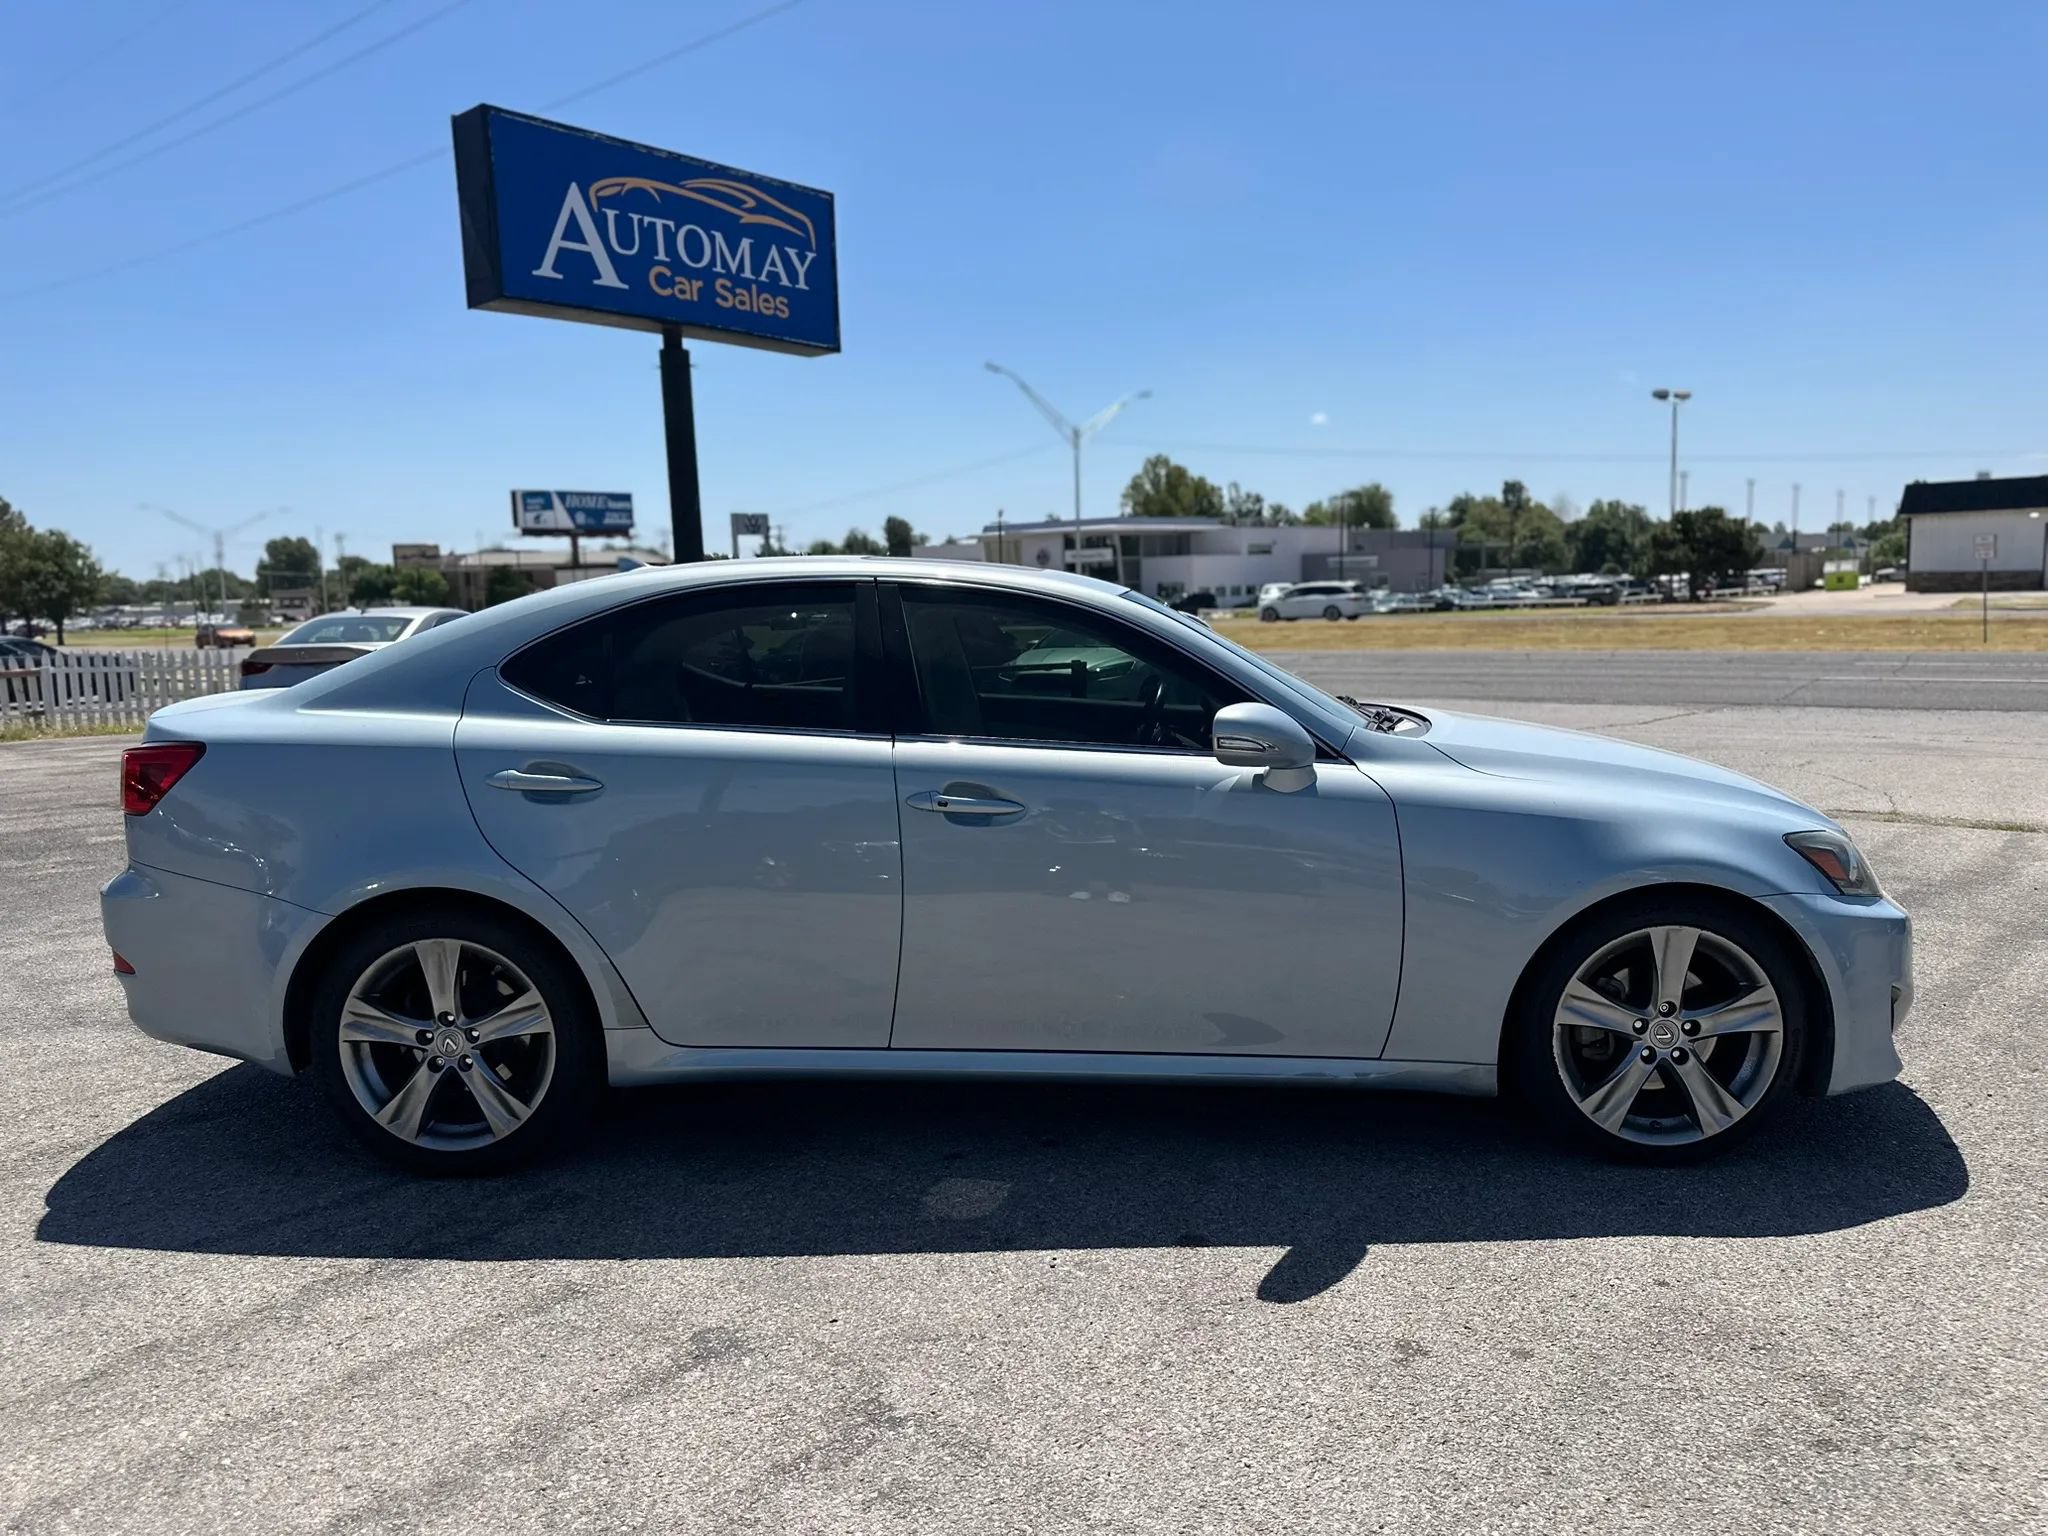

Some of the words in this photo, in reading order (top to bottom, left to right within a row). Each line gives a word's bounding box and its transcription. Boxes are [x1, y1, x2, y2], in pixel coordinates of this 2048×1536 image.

[532, 181, 816, 290] AUTOMAY
[648, 265, 704, 302] Car
[714, 279, 790, 319] Sales
